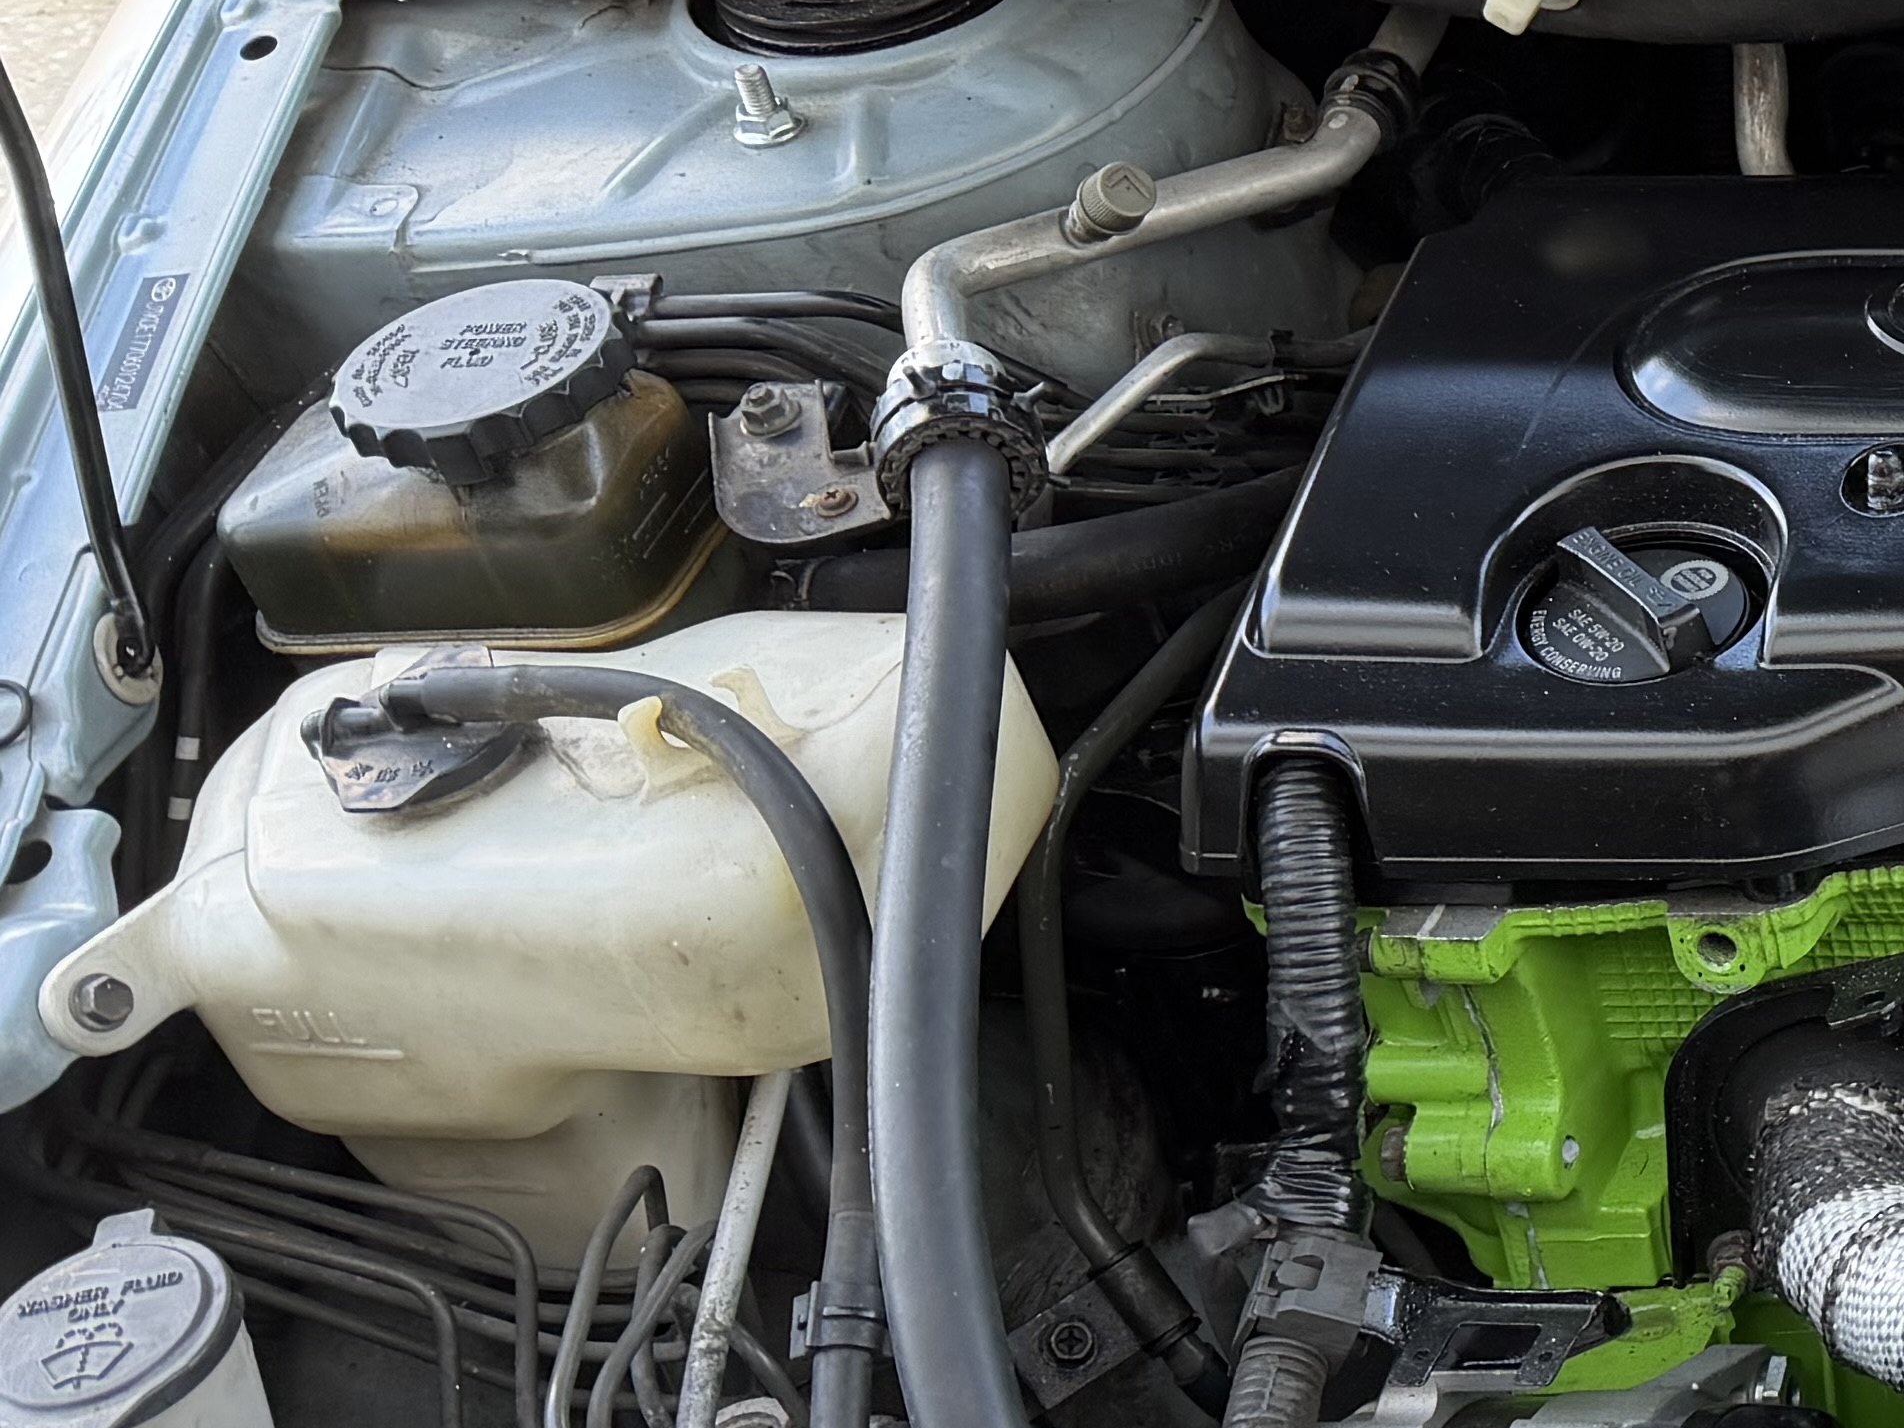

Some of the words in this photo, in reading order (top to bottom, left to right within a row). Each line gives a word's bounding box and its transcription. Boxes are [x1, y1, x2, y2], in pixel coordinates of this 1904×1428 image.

[1571, 531, 1619, 571] ENGINE
[1616, 564, 1645, 589] OIL
[1529, 608, 1549, 649] ENERGY
[1540, 645, 1622, 680] CONSERVING
[1552, 617, 1577, 637] SAE
[1573, 632, 1609, 663] 0W-20
[1567, 608, 1593, 631] SAE
[1590, 625, 1625, 653] 5W-20
[251, 1007, 368, 1045] FULL
[120, 1269, 184, 1297] FLUID
